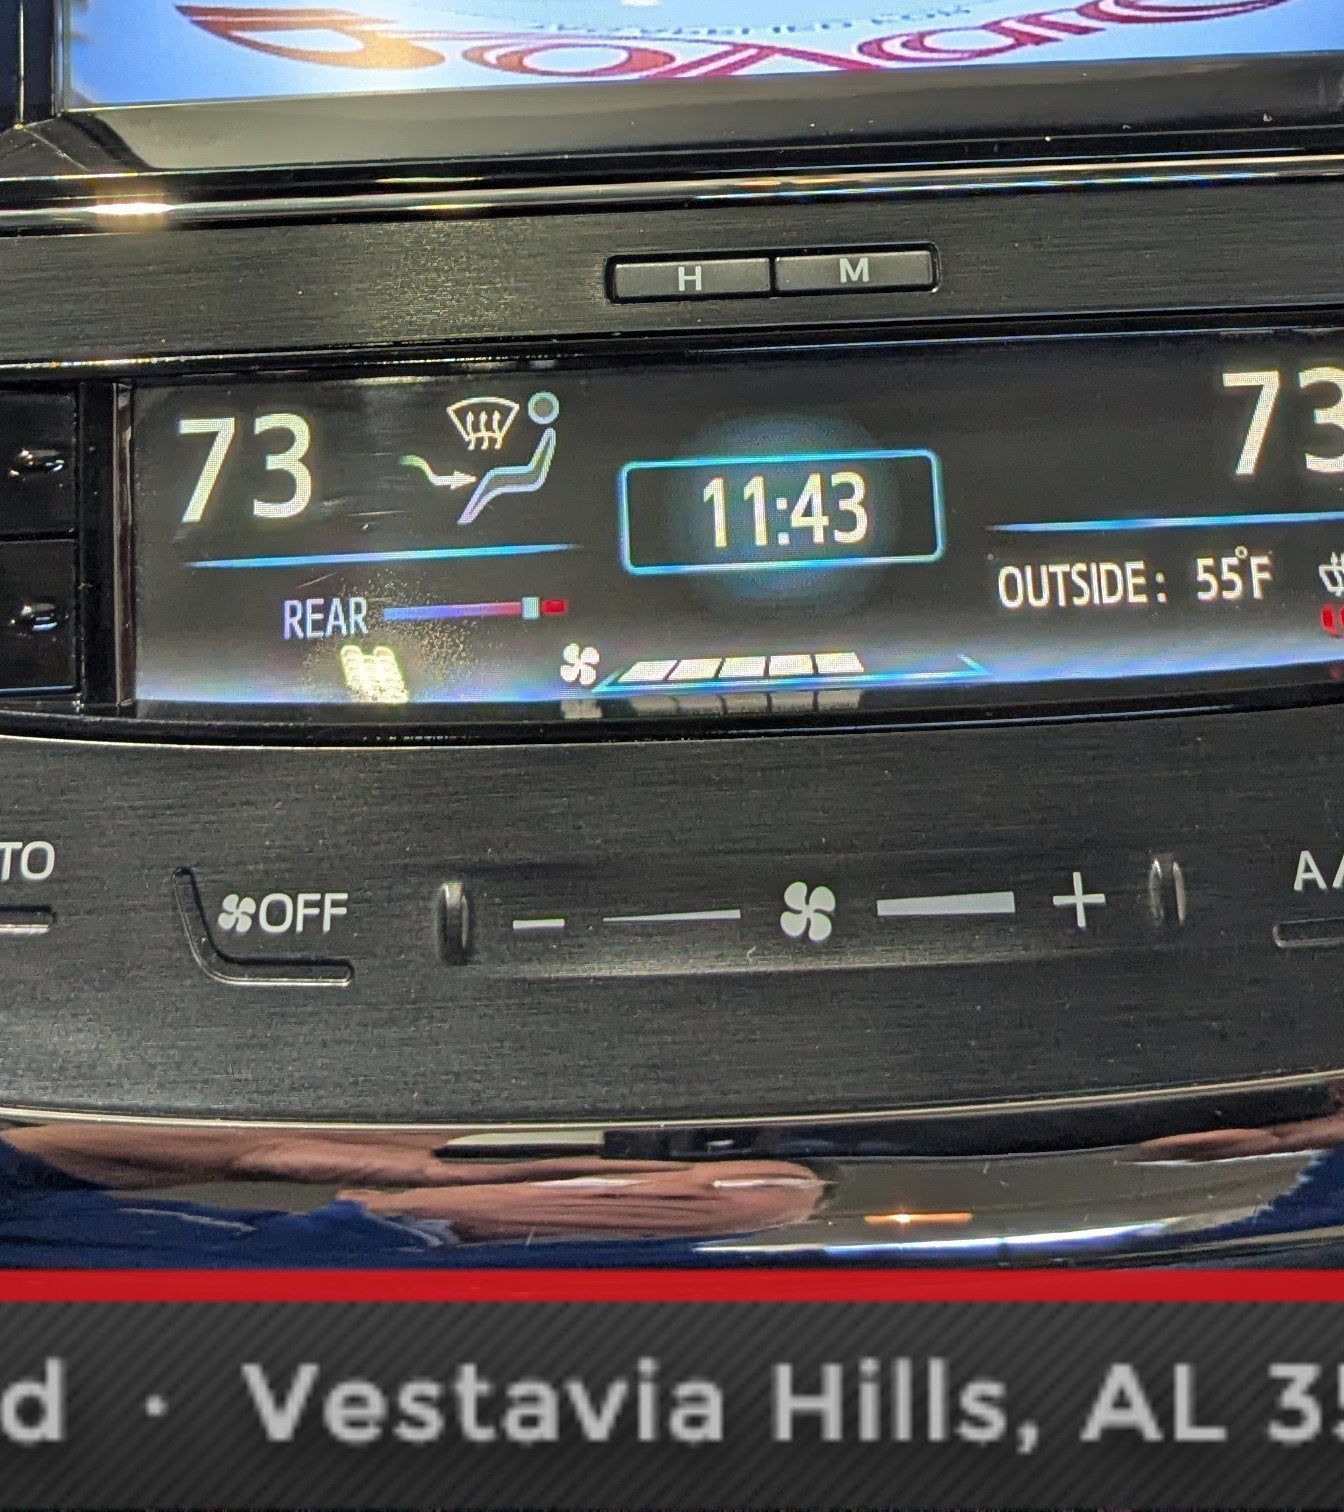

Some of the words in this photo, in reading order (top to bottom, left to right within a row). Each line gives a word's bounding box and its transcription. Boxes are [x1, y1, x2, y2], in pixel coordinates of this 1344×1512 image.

[677, 266, 702, 292] H
[839, 257, 869, 283] M
[176, 411, 315, 525] 73
[701, 471, 869, 549] 11:43
[282, 596, 369, 640] REAR
[258, 892, 348, 934] OFF
